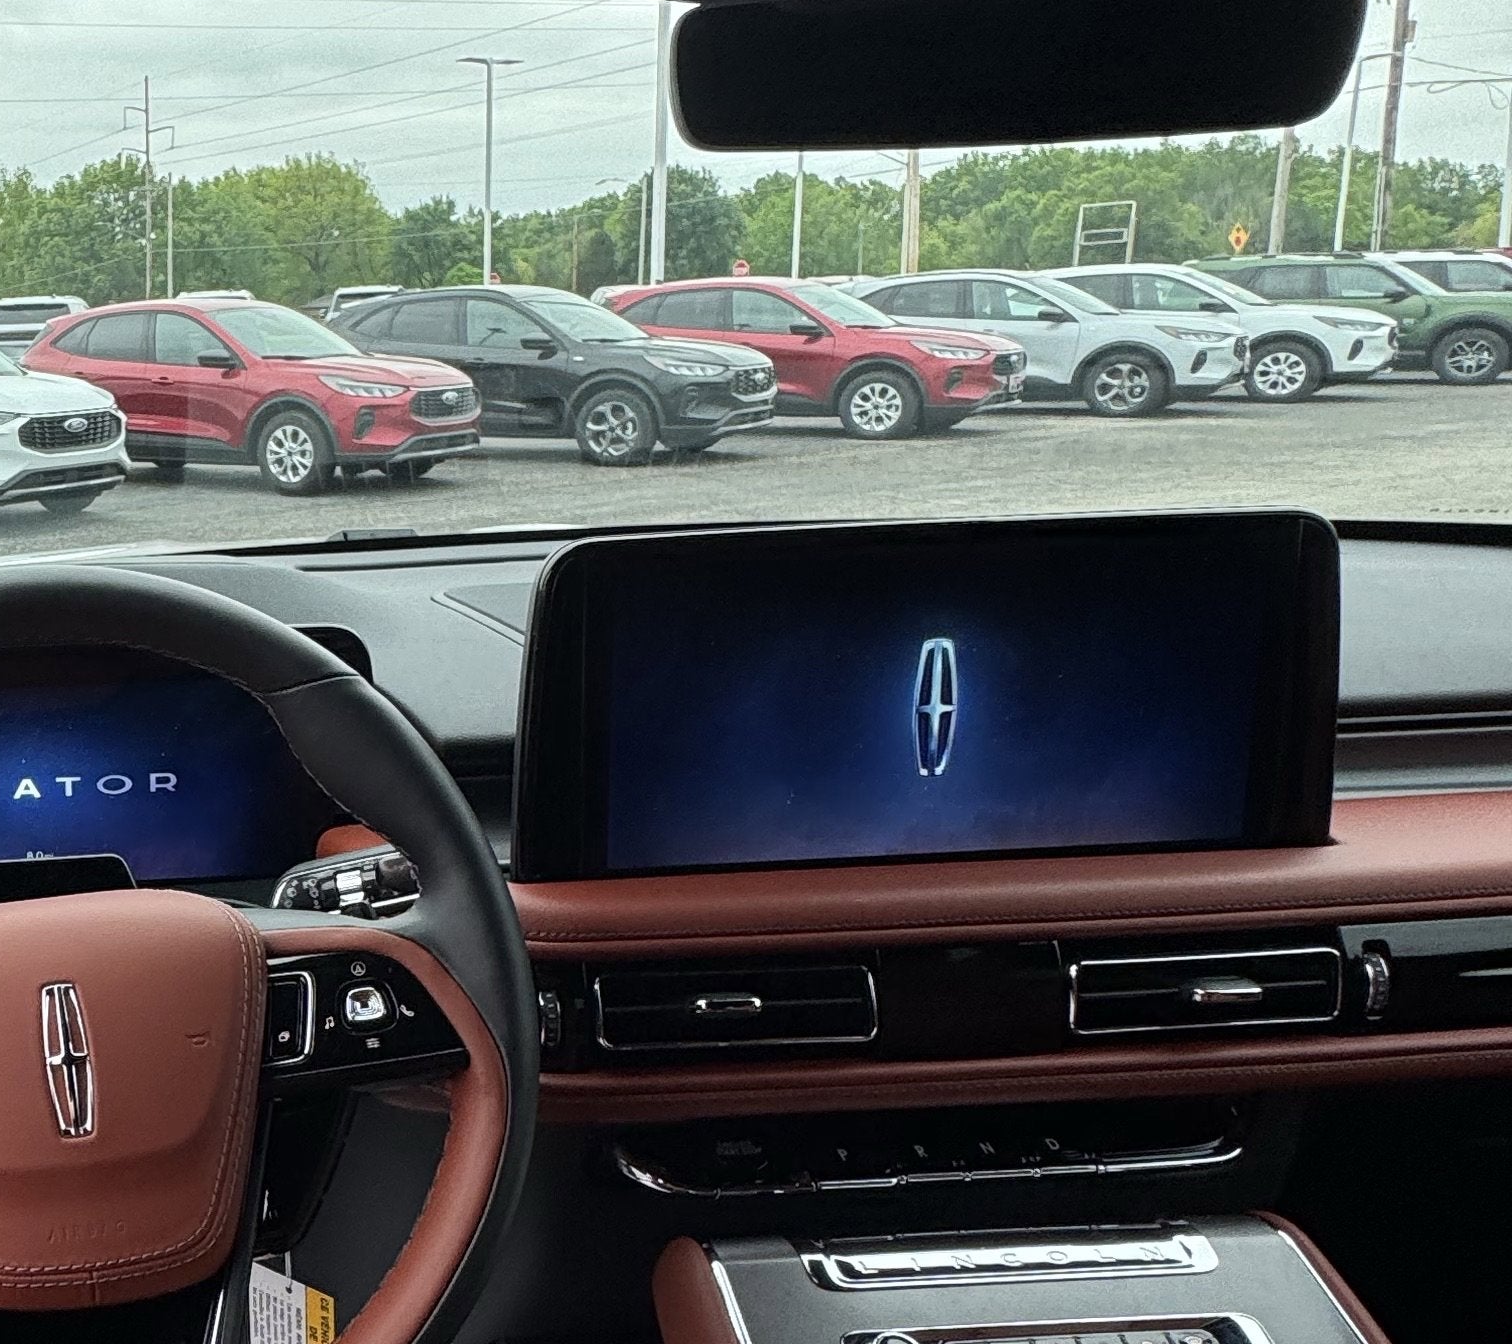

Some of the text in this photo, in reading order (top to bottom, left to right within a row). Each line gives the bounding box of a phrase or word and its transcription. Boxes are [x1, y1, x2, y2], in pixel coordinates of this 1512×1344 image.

[837, 1138, 1060, 1162] P R N D
[855, 1246, 1170, 1274] LINCOLN
